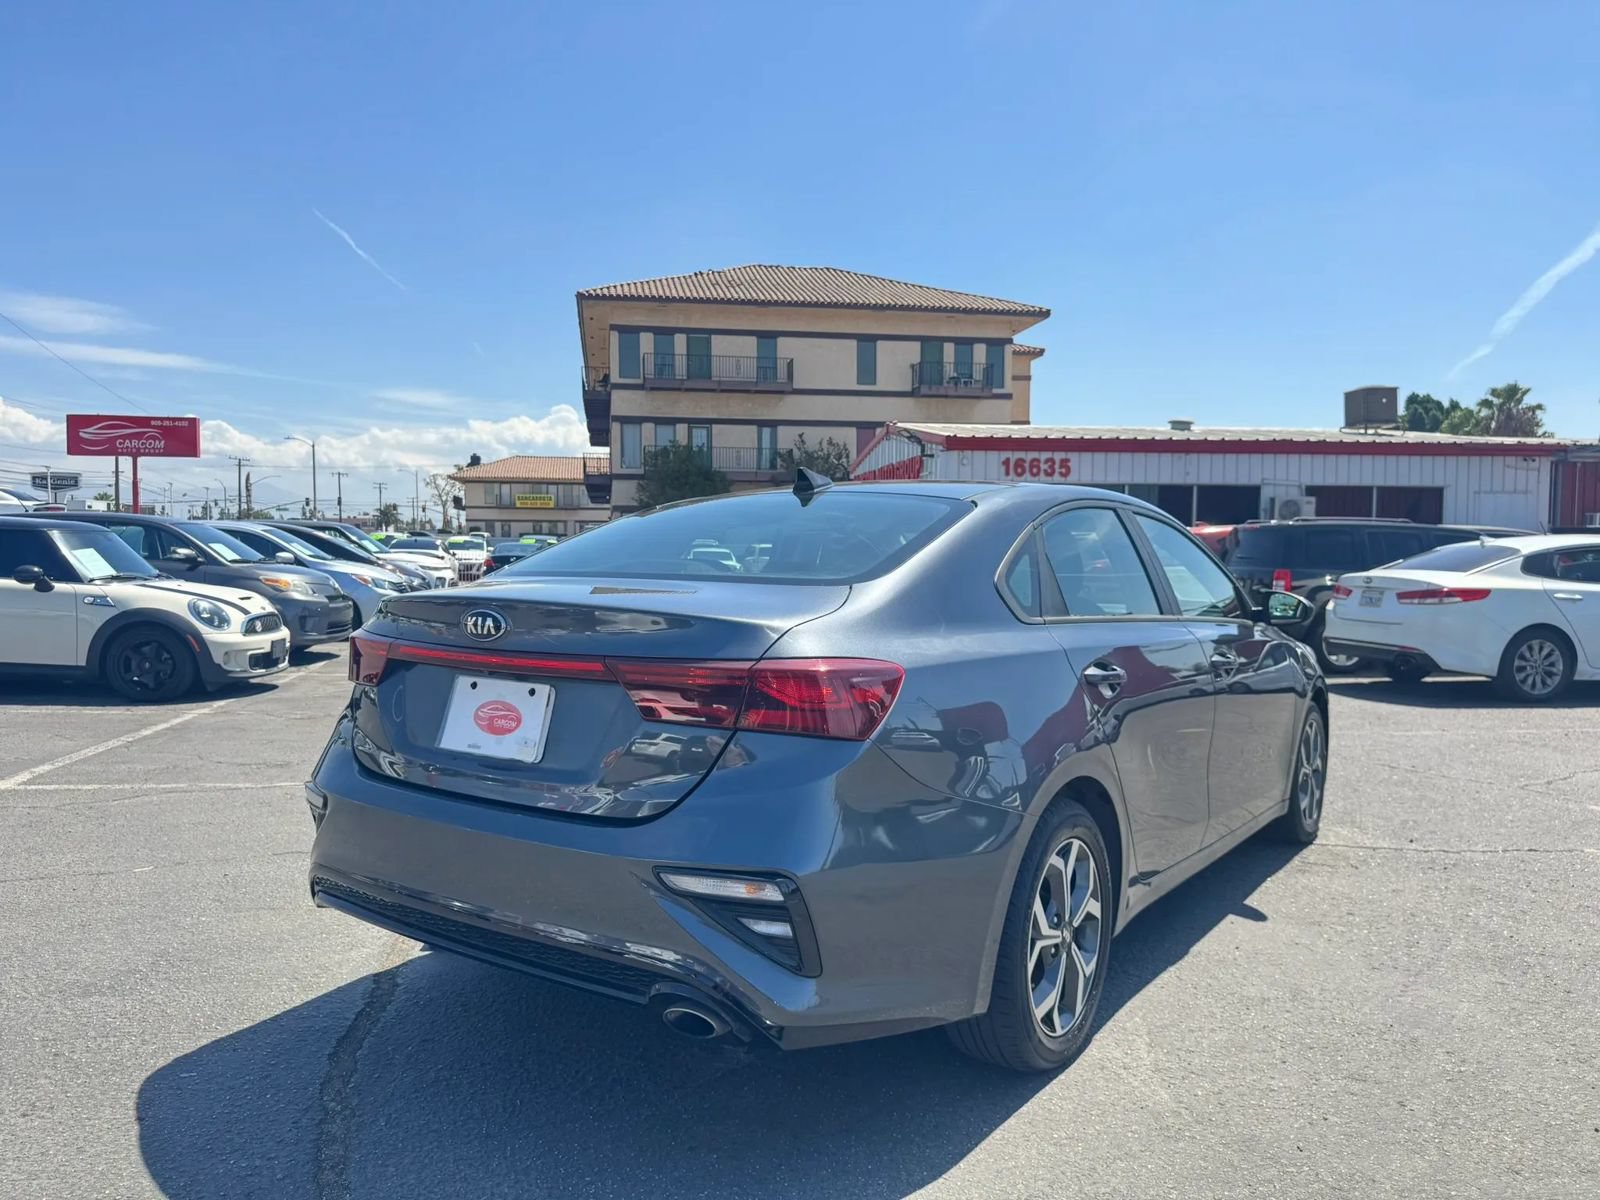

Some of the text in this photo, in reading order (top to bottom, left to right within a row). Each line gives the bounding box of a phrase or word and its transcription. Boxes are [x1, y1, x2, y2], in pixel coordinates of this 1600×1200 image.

[116, 439, 165, 449] CARCOM
[1001, 457, 1072, 478] 16635
[467, 616, 496, 635] KIA
